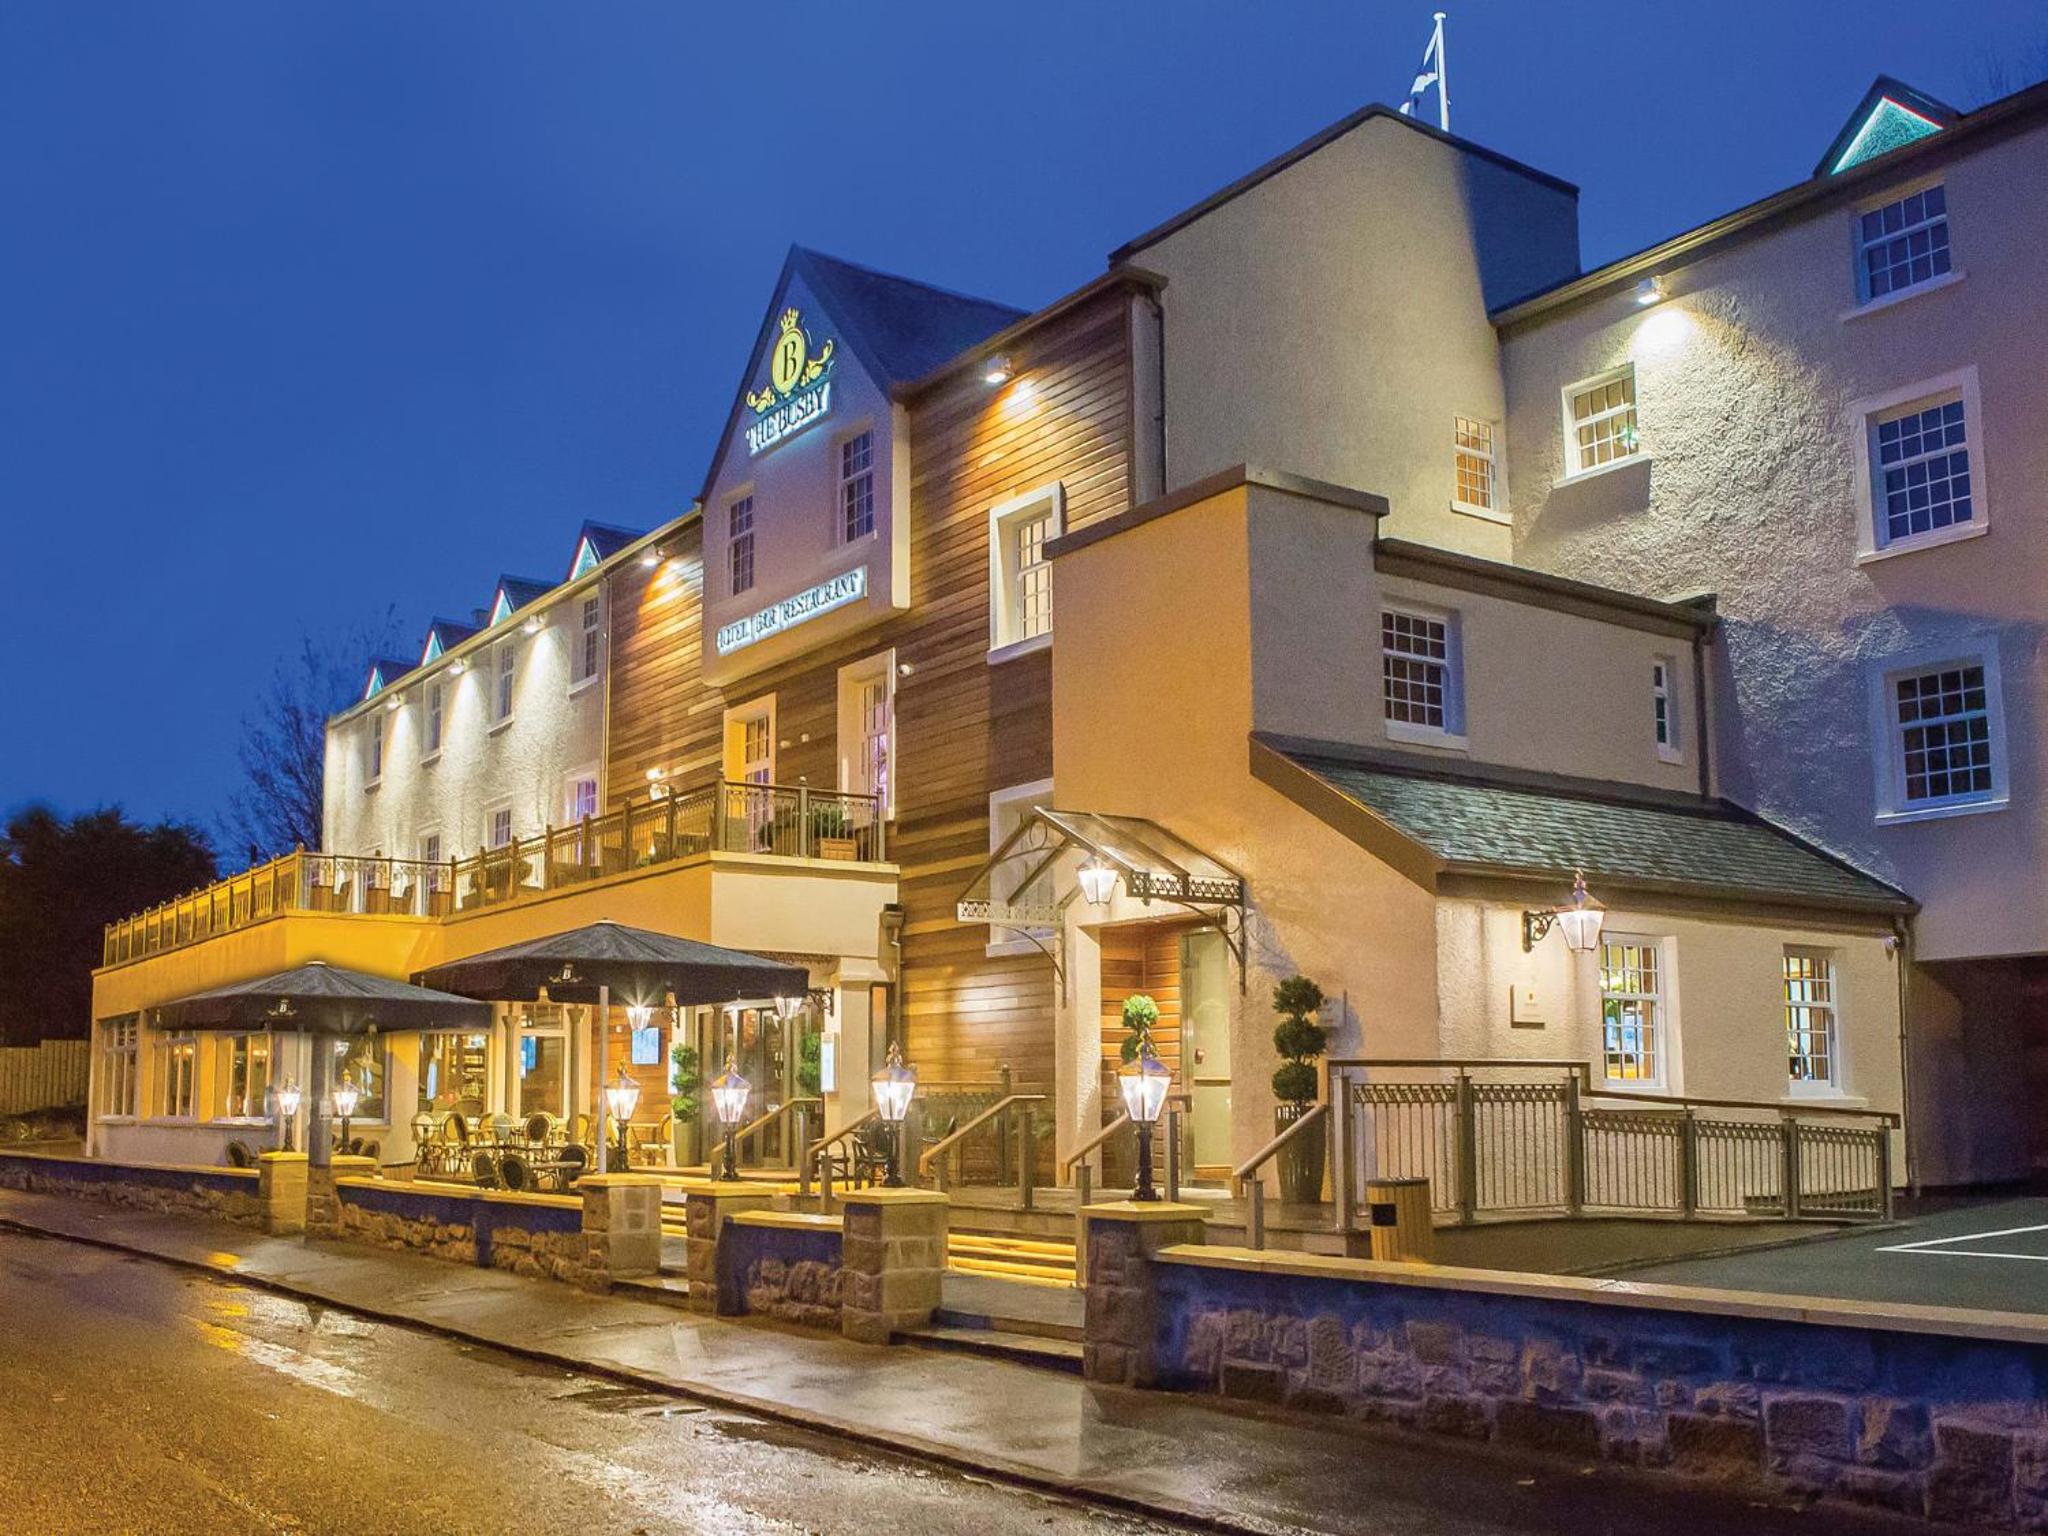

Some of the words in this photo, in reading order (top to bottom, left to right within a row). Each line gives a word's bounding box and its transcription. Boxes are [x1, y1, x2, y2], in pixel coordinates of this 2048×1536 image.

[783, 340, 798, 382] B
[745, 413, 778, 451] THE
[779, 382, 831, 433] BUSBY
[780, 572, 858, 620] RESTAURANT
